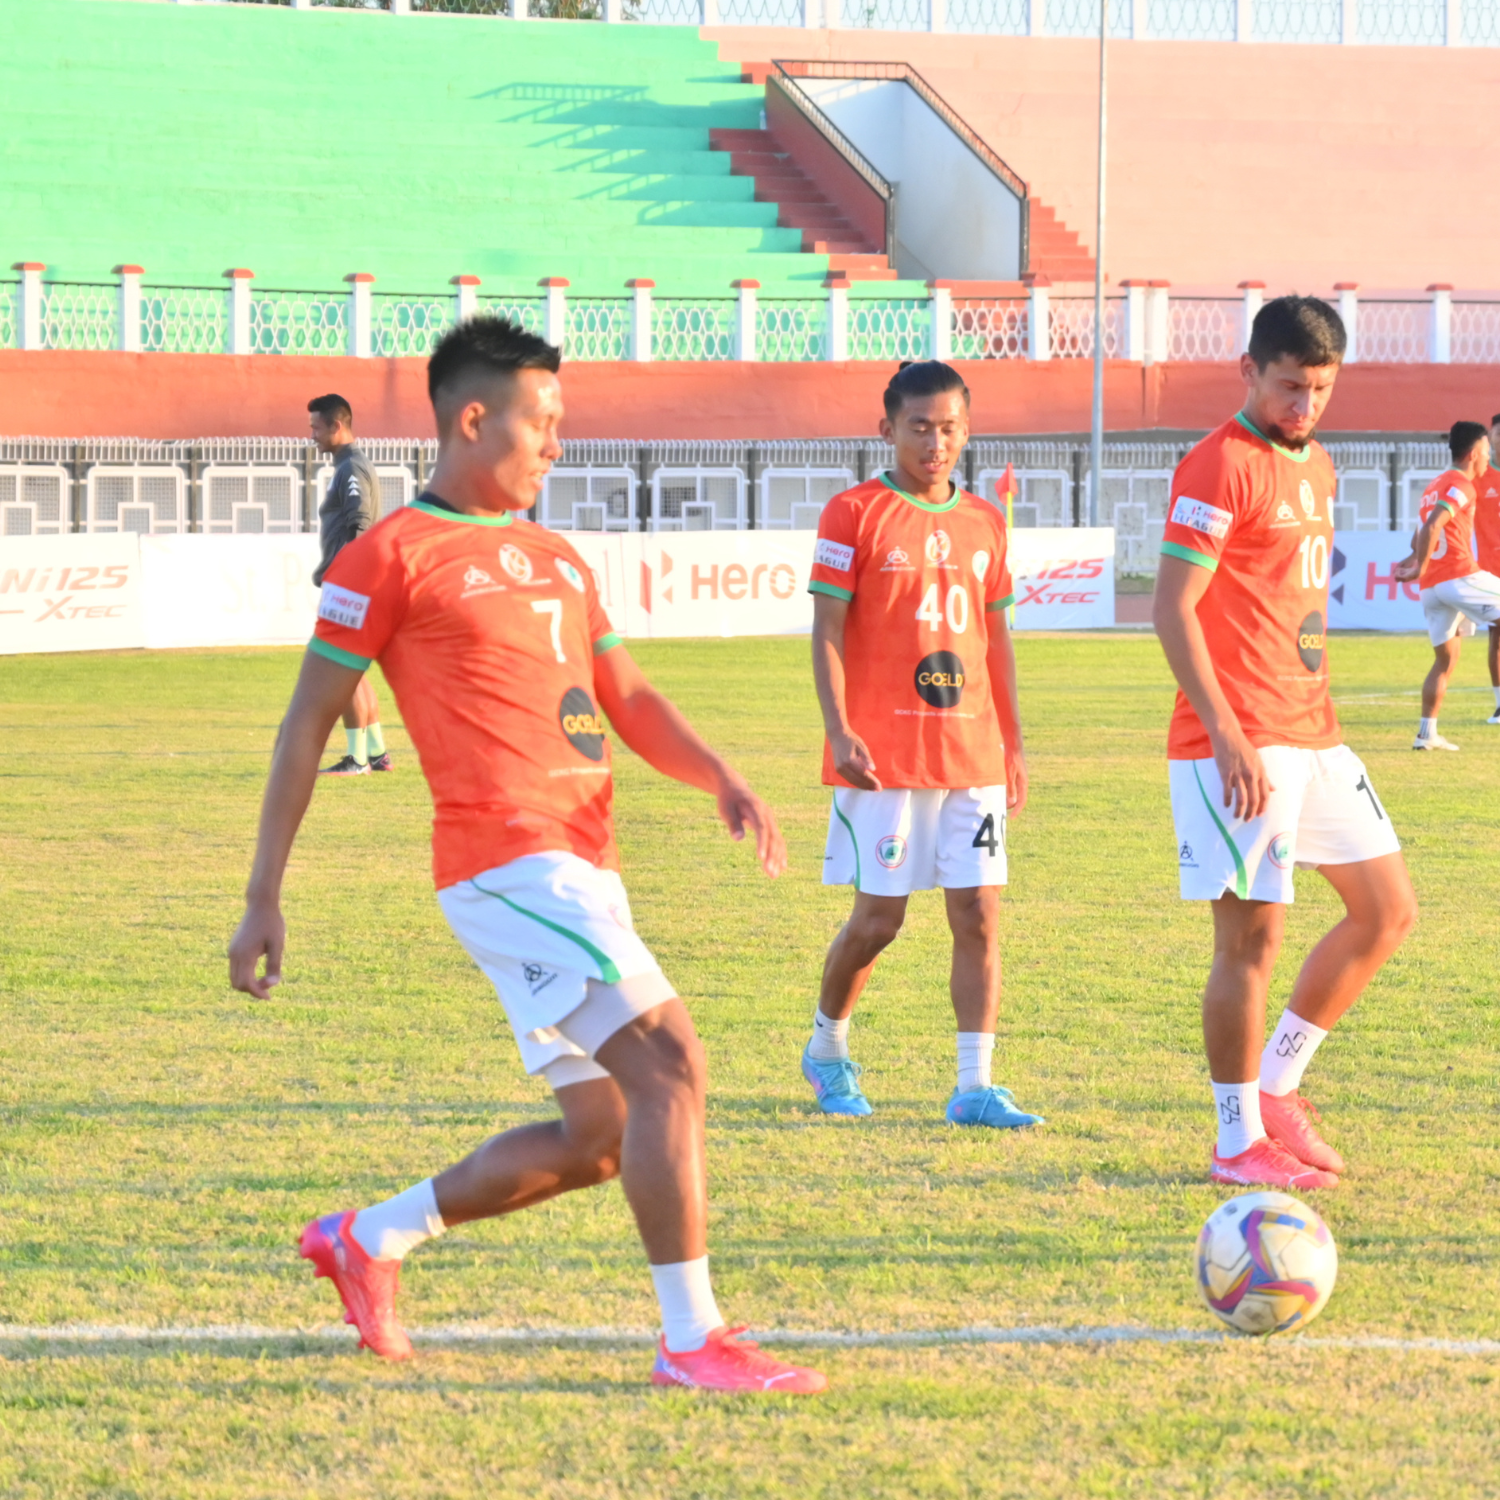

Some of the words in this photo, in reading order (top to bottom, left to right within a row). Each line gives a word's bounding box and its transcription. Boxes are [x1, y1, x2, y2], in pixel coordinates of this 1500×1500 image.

[691, 563, 796, 600] Hero
[1299, 535, 1328, 589] 10
[33, 595, 127, 622] XTEC
[915, 583, 968, 634] 40
[1014, 583, 1101, 606] XTEC
[530, 599, 566, 663] 7
[972, 812, 1006, 858] 4
